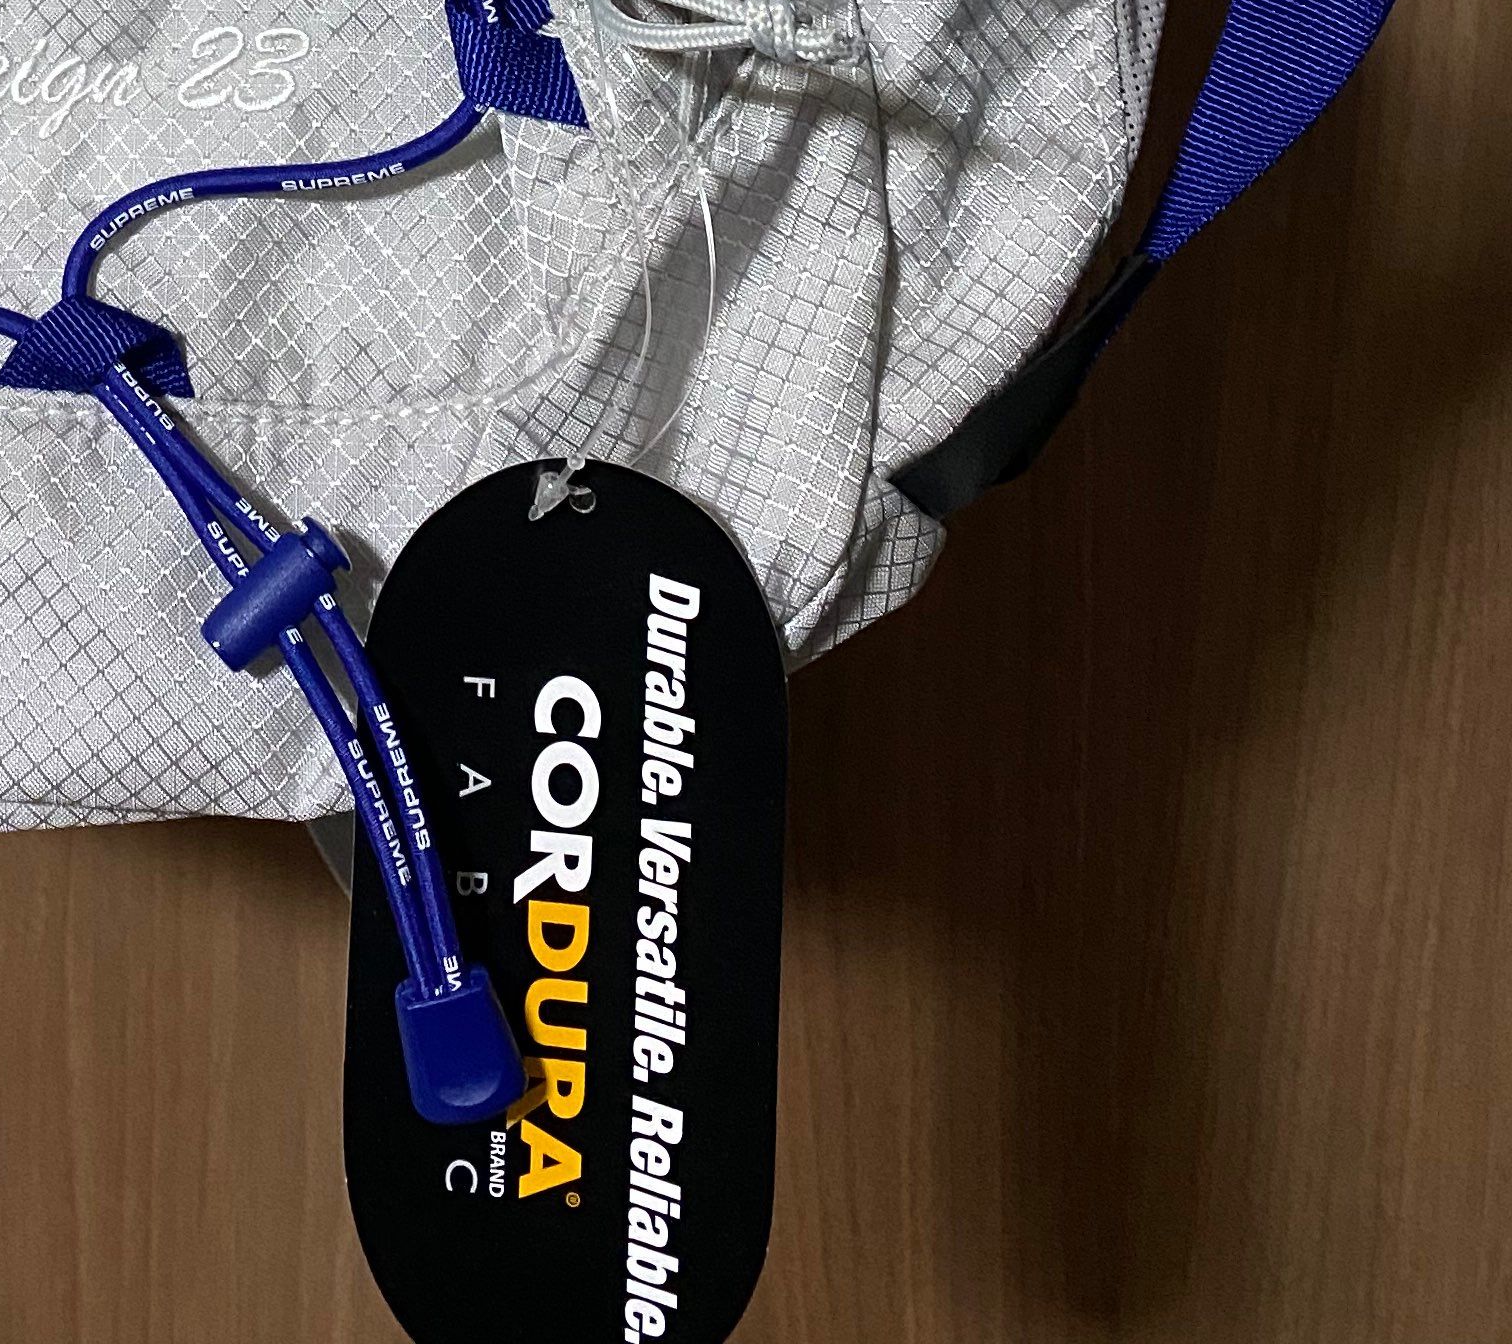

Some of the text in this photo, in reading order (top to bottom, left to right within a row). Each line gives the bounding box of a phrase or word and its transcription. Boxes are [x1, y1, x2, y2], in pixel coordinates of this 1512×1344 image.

[177, 26, 311, 112] 23
[89, 187, 195, 251] SUPREME
[280, 162, 405, 194] SUPREME
[347, 738, 412, 887] SUPREME
[372, 701, 431, 851] SUPREME
[623, 572, 701, 1344] Durable. Versatile. Reliable.
[488, 1130, 507, 1198] BRAND
